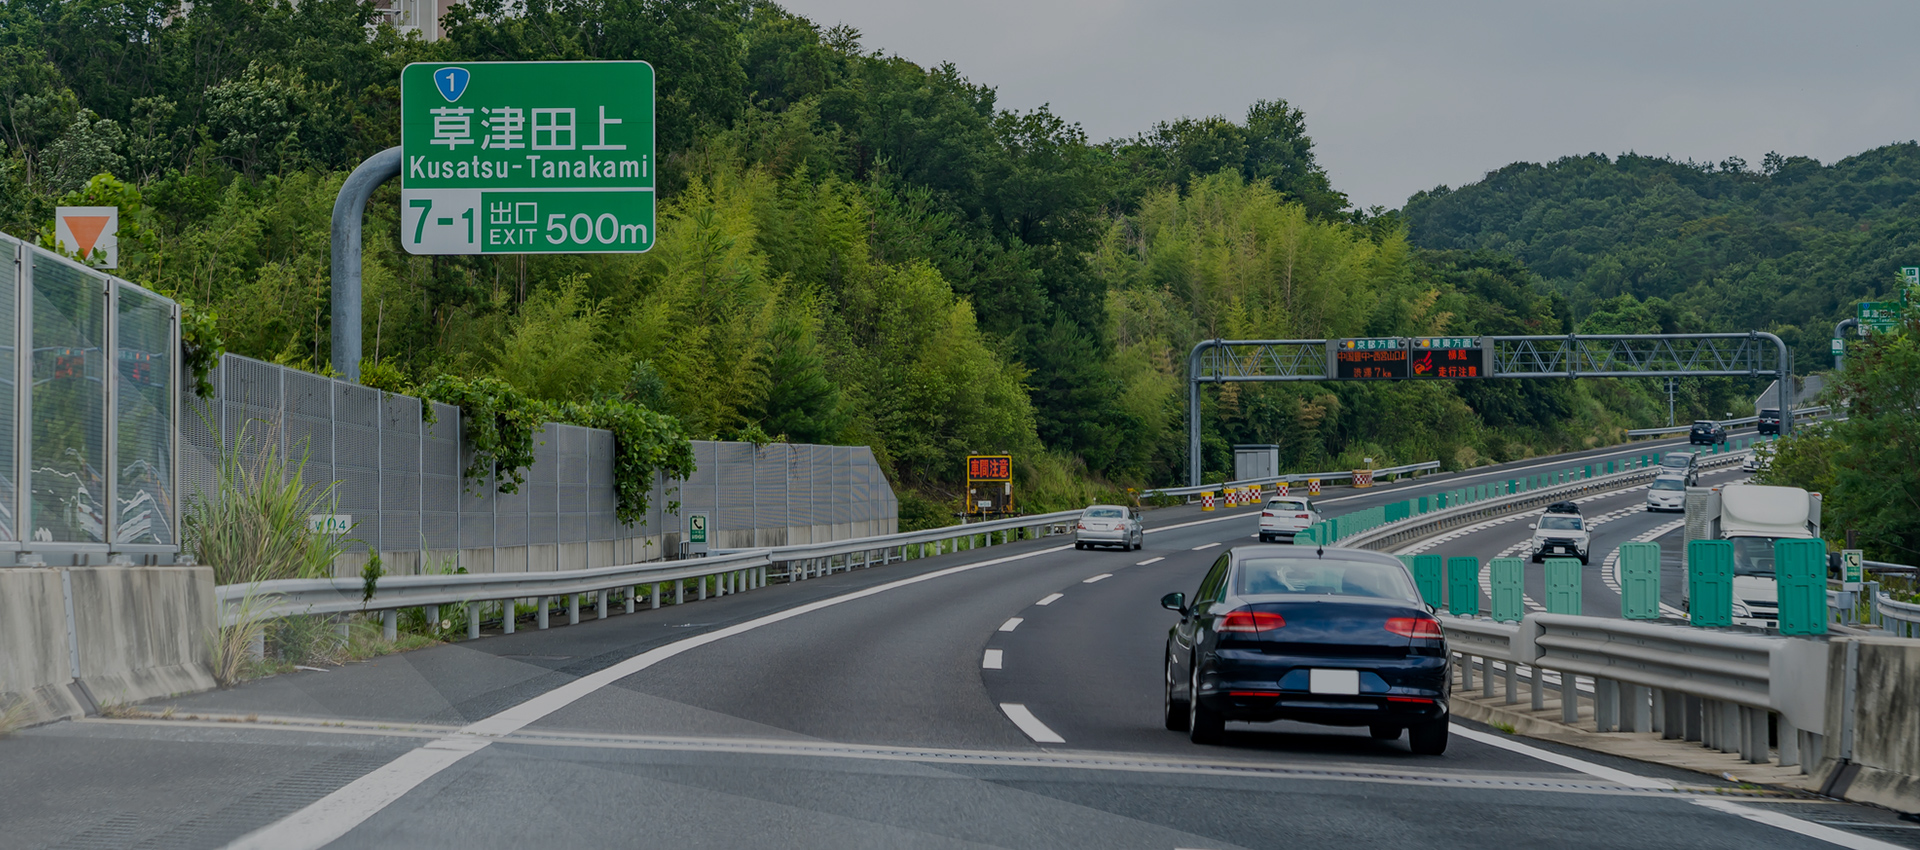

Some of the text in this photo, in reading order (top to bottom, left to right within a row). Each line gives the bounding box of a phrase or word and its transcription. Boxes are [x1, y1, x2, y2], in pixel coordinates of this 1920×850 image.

[445, 73, 455, 92] 1
[429, 105, 627, 151] 草津田上
[409, 154, 648, 179] Kusatsu-Tanakami
[408, 199, 474, 244] 7-1
[490, 201, 538, 225] 出口
[489, 229, 538, 245] EXIT
[545, 212, 648, 245] 500m
[1357, 340, 1397, 349] 京都方面
[1438, 366, 1477, 378] 走行注意
[970, 459, 1009, 478] 車間注意
